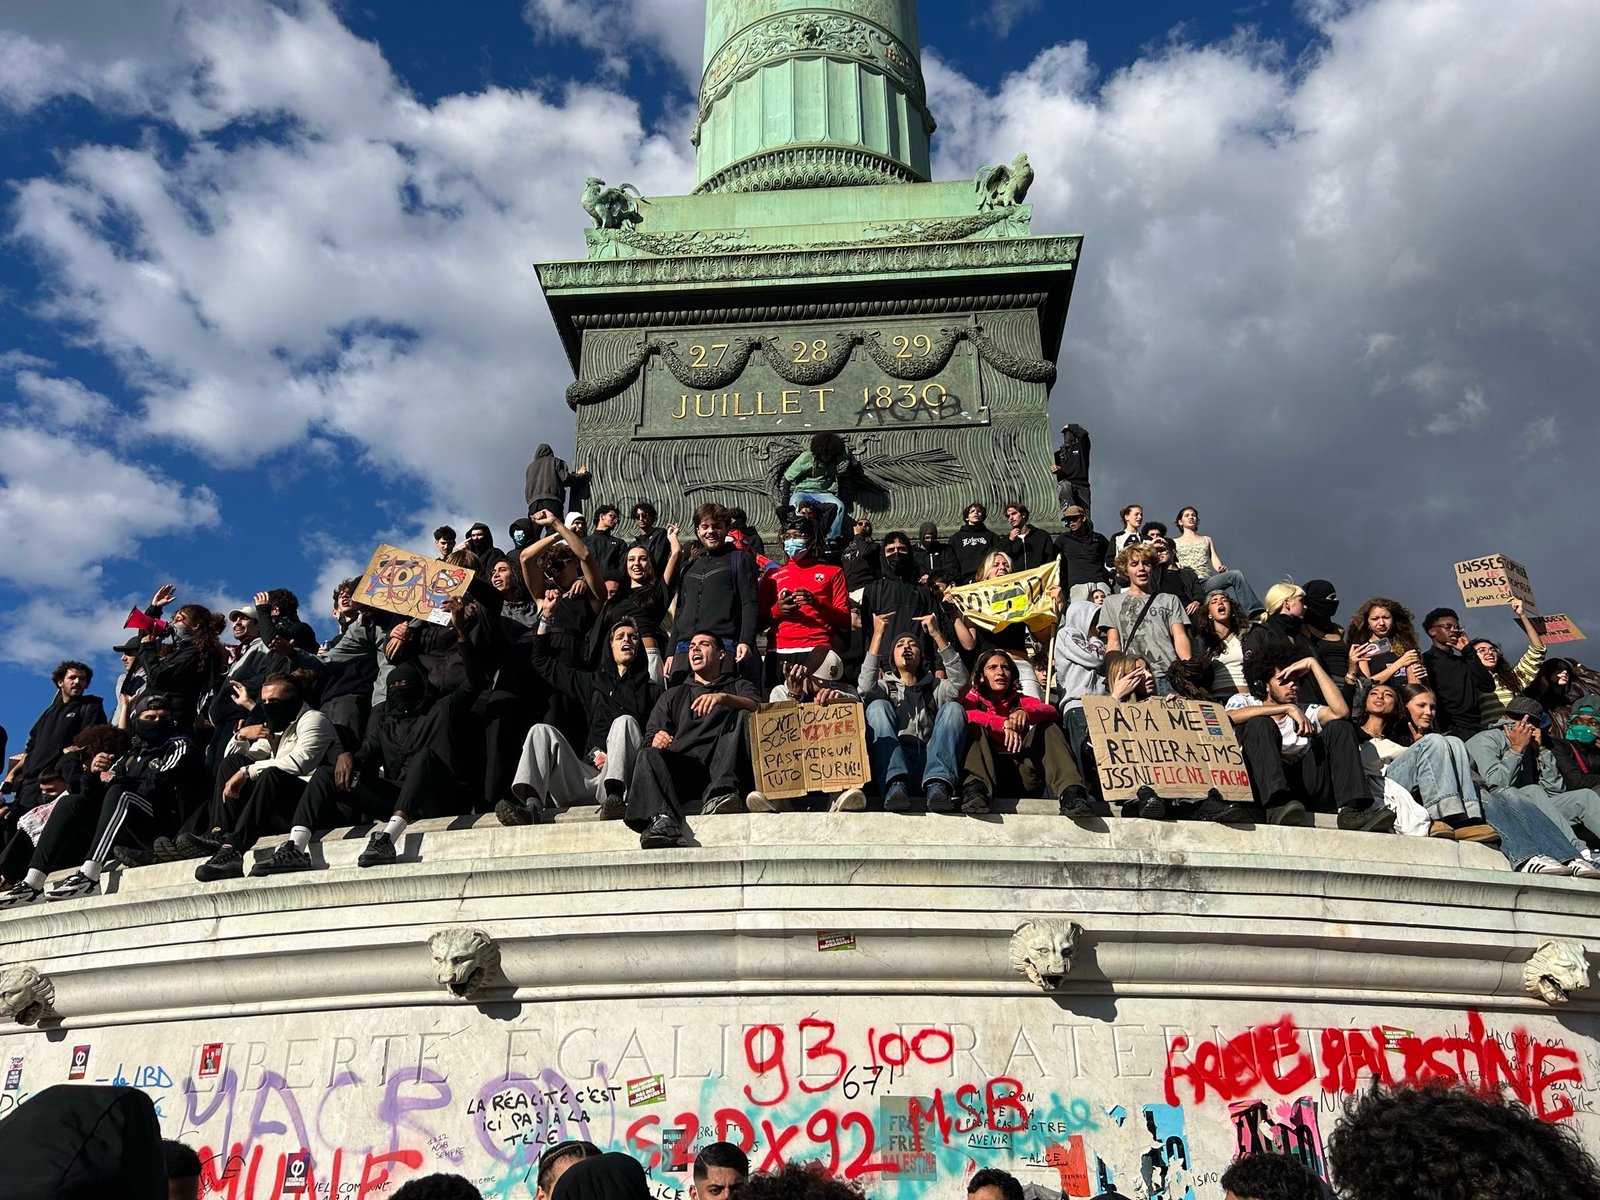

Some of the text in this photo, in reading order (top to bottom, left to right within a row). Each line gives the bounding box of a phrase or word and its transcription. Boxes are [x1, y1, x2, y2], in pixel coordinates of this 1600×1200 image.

[689, 335, 932, 368] 27 28 29
[671, 383, 947, 420] JUILLET 1830
[854, 393, 962, 426] ACAB
[1457, 556, 1505, 574] LAISSES
[1463, 576, 1507, 589] LAISSES
[1095, 705, 1203, 734] PAPA ME
[764, 752, 792, 768] PAS
[1196, 743, 1244, 766] JMS
[763, 768, 801, 788] TUTO
[1154, 766, 1186, 785] FLIC
[1187, 766, 1208, 785] NI
[1211, 767, 1249, 787] FACHO
[184, 1020, 451, 1096] LIBERTÉ
[502, 1009, 841, 1083] ÉGALITÉ
[744, 1017, 848, 1106] 93
[133, 1065, 173, 1088] LBD
[467, 1099, 486, 1115] LA
[908, 1077, 1029, 1152] MSB
[511, 1112, 543, 1130] PAS
[568, 1110, 590, 1124] LA
